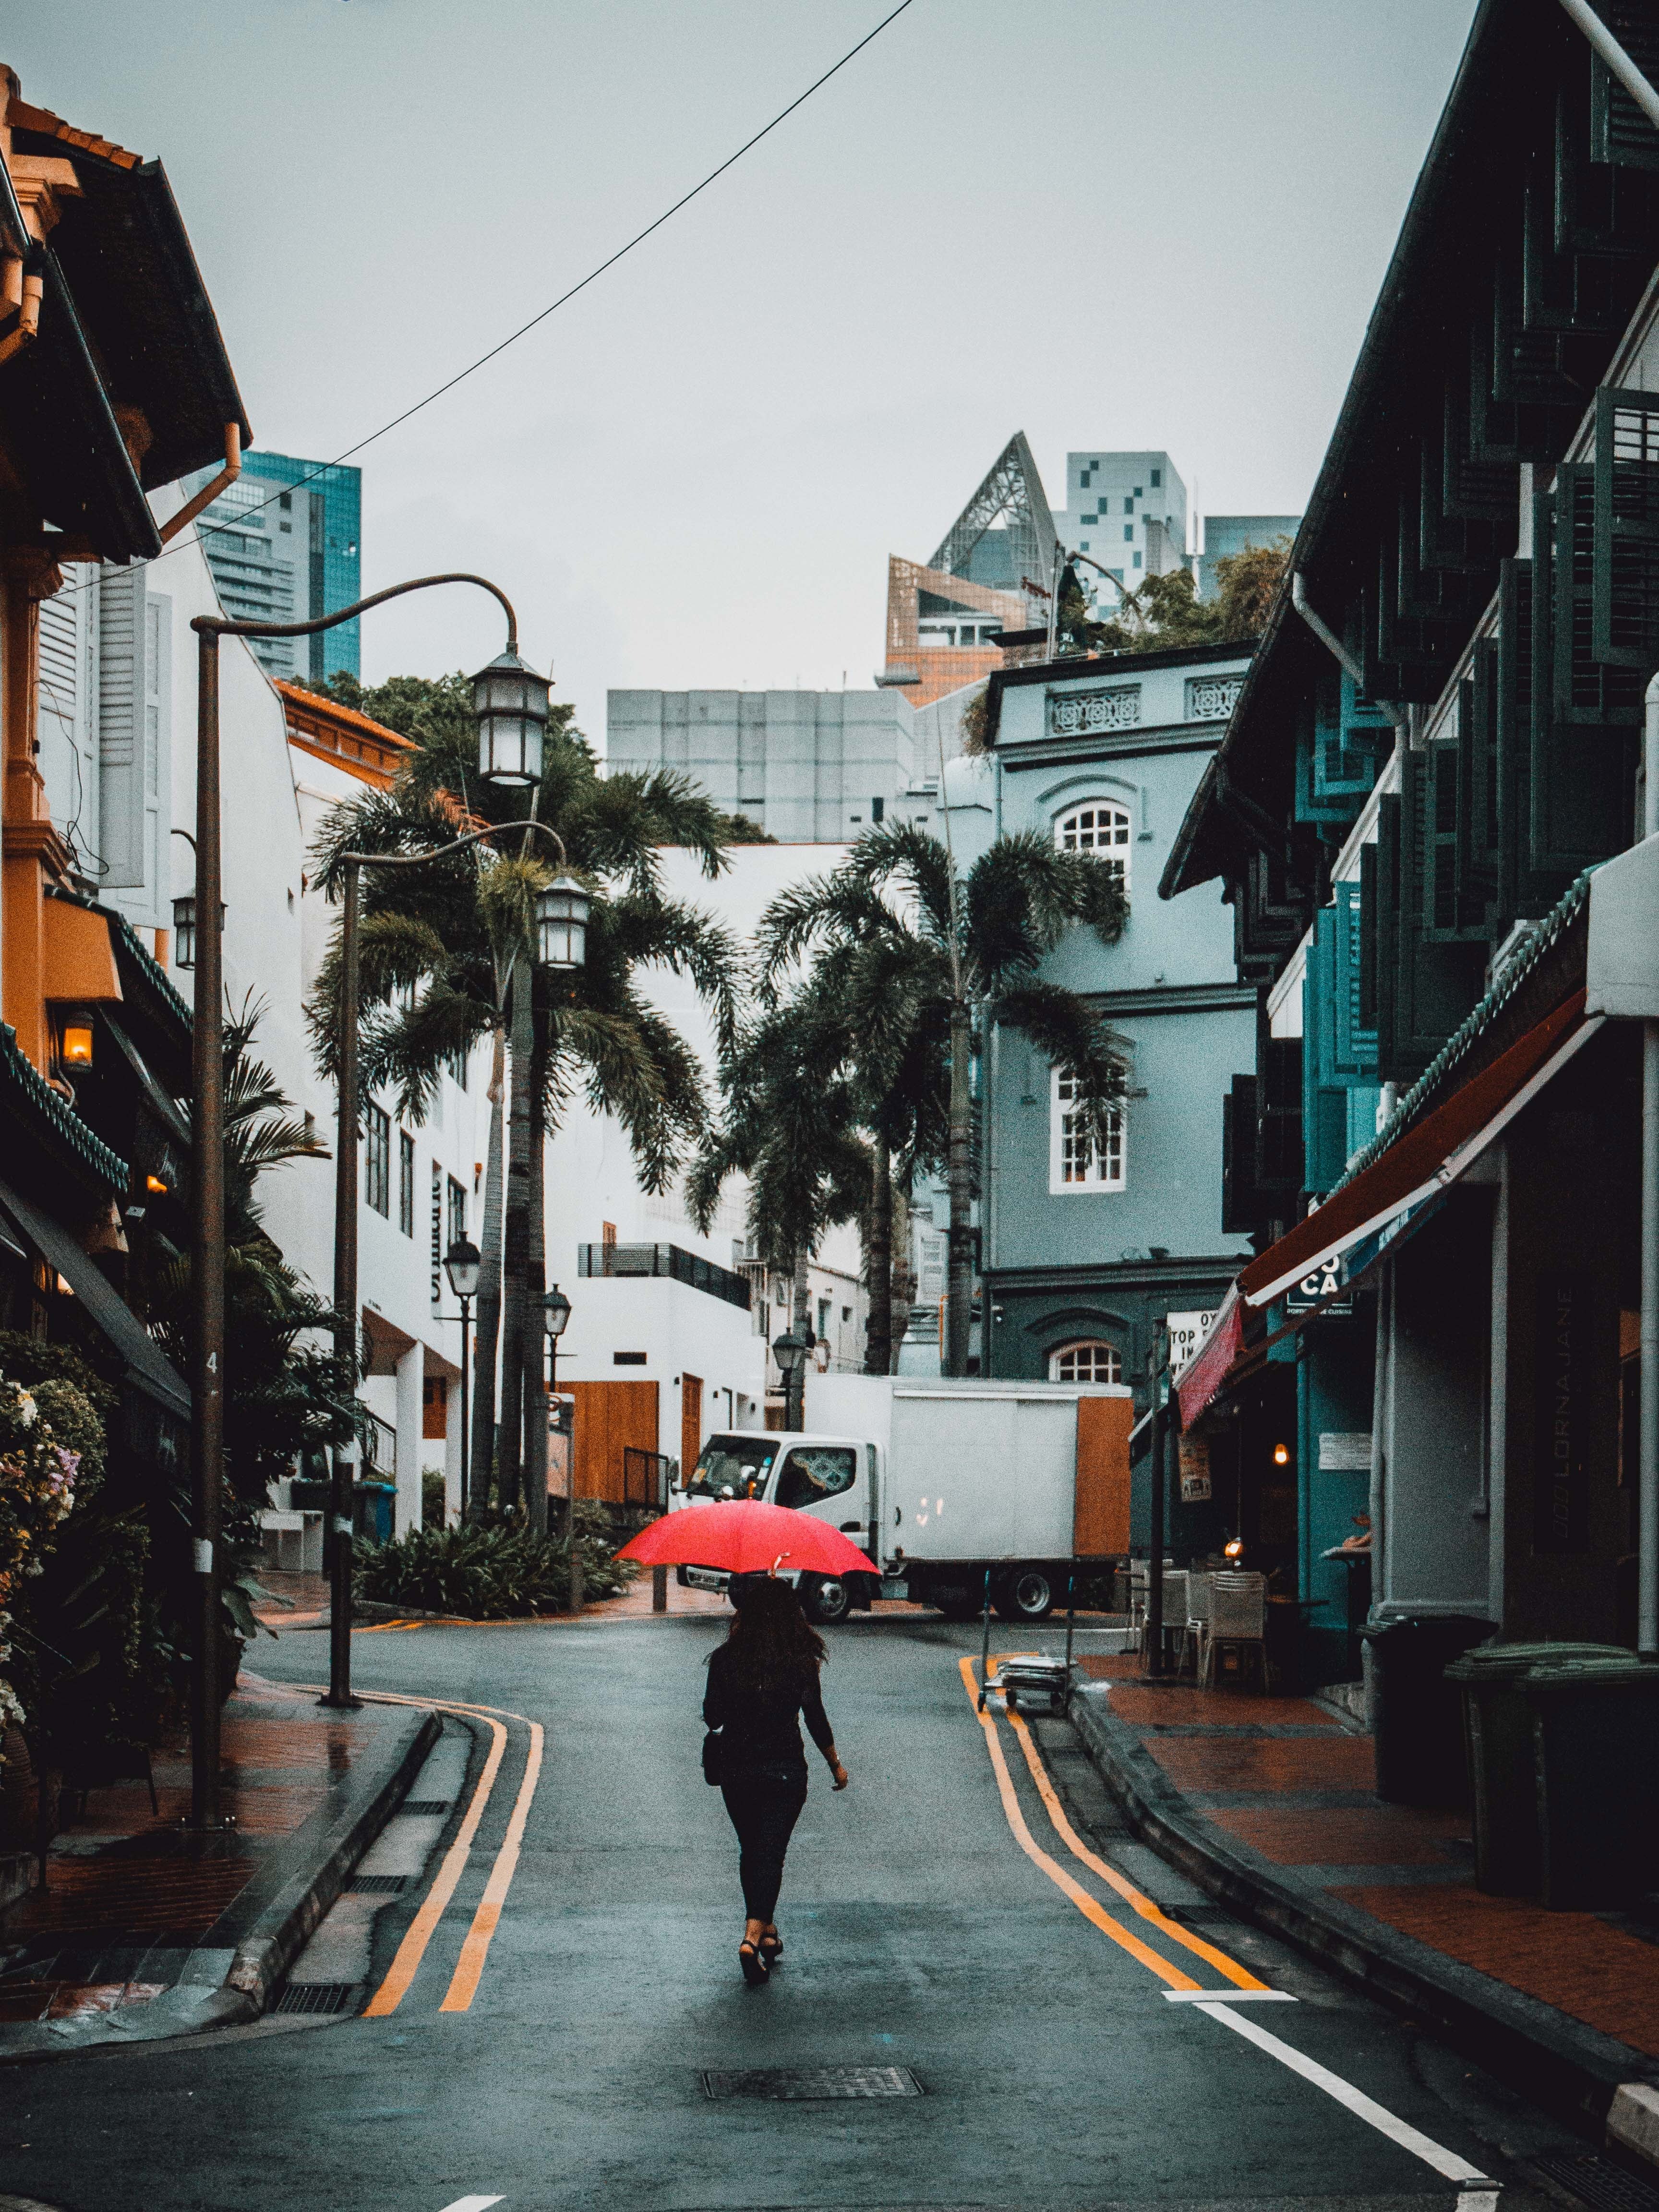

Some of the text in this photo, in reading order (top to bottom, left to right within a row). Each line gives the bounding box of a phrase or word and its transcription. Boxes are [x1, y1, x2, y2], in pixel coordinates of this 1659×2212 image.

[1300, 1274, 1338, 1295] CA
[1171, 1331, 1195, 1343] TOP
[206, 1352, 217, 1373] 4
